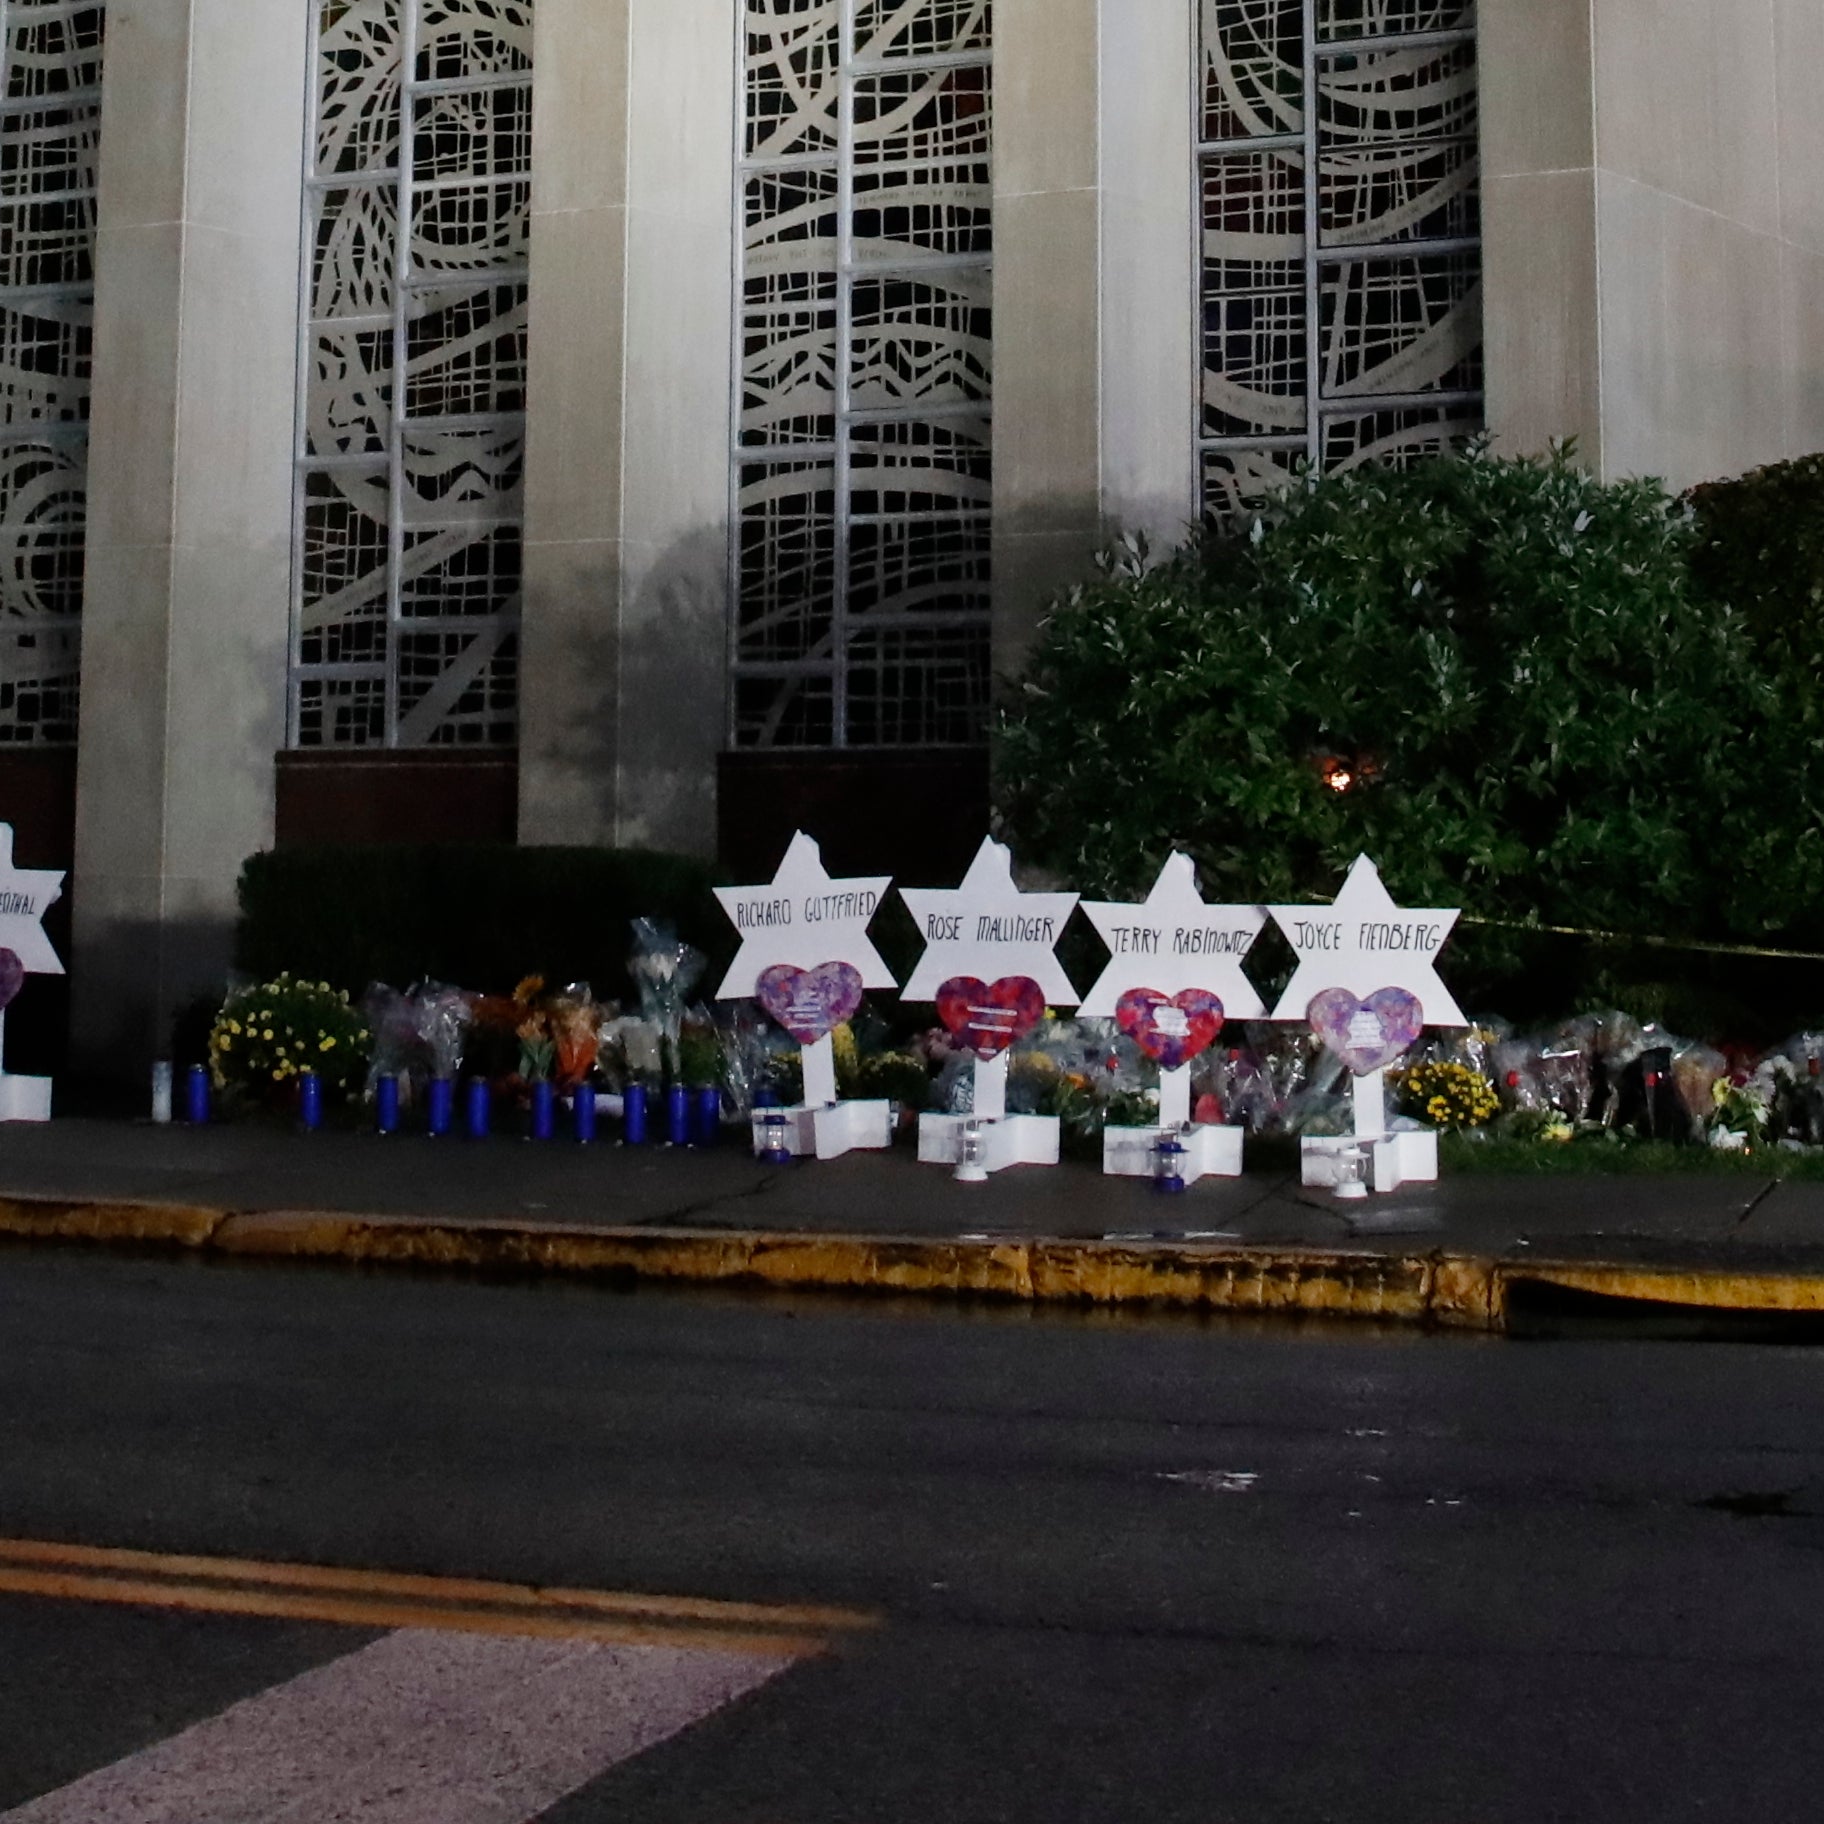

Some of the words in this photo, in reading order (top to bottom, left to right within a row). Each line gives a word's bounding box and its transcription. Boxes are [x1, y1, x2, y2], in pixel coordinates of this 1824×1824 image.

[737, 898, 792, 928] RICHARD
[927, 915, 964, 941] ROSE
[976, 914, 1054, 943] MALLINGER
[1111, 926, 1162, 953] TERRY
[1172, 926, 1253, 956] RABINOWITZ
[1293, 920, 1343, 951] JOYCE
[1359, 921, 1441, 951] FIENBERG
